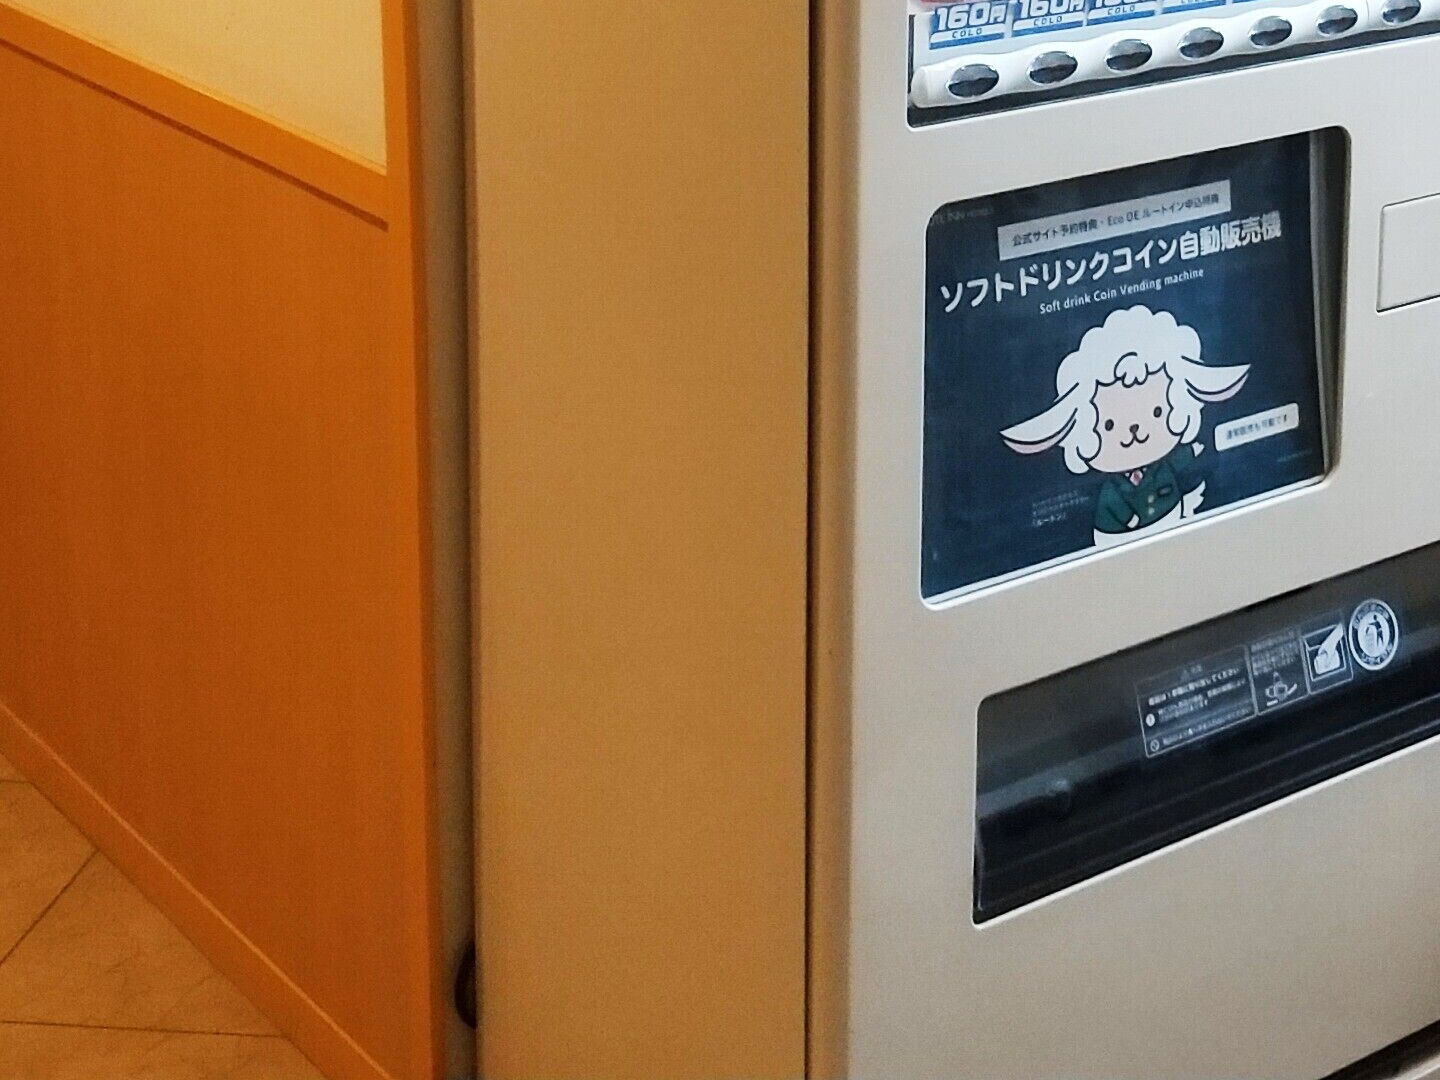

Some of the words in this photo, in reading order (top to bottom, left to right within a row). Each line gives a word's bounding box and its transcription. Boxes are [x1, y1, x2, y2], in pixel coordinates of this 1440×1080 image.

[1107, 4, 1135, 16] COLD
[1033, 15, 1063, 26] COLD
[951, 27, 983, 39] COLD
[940, 211, 1282, 313] ソフトドリンクコイン自動販売機
[1039, 299, 1061, 314] Soft
[1064, 293, 1091, 311] drink
[1093, 286, 1117, 302] Coin
[1119, 277, 1162, 298] Vending
[1164, 267, 1204, 286] machine
